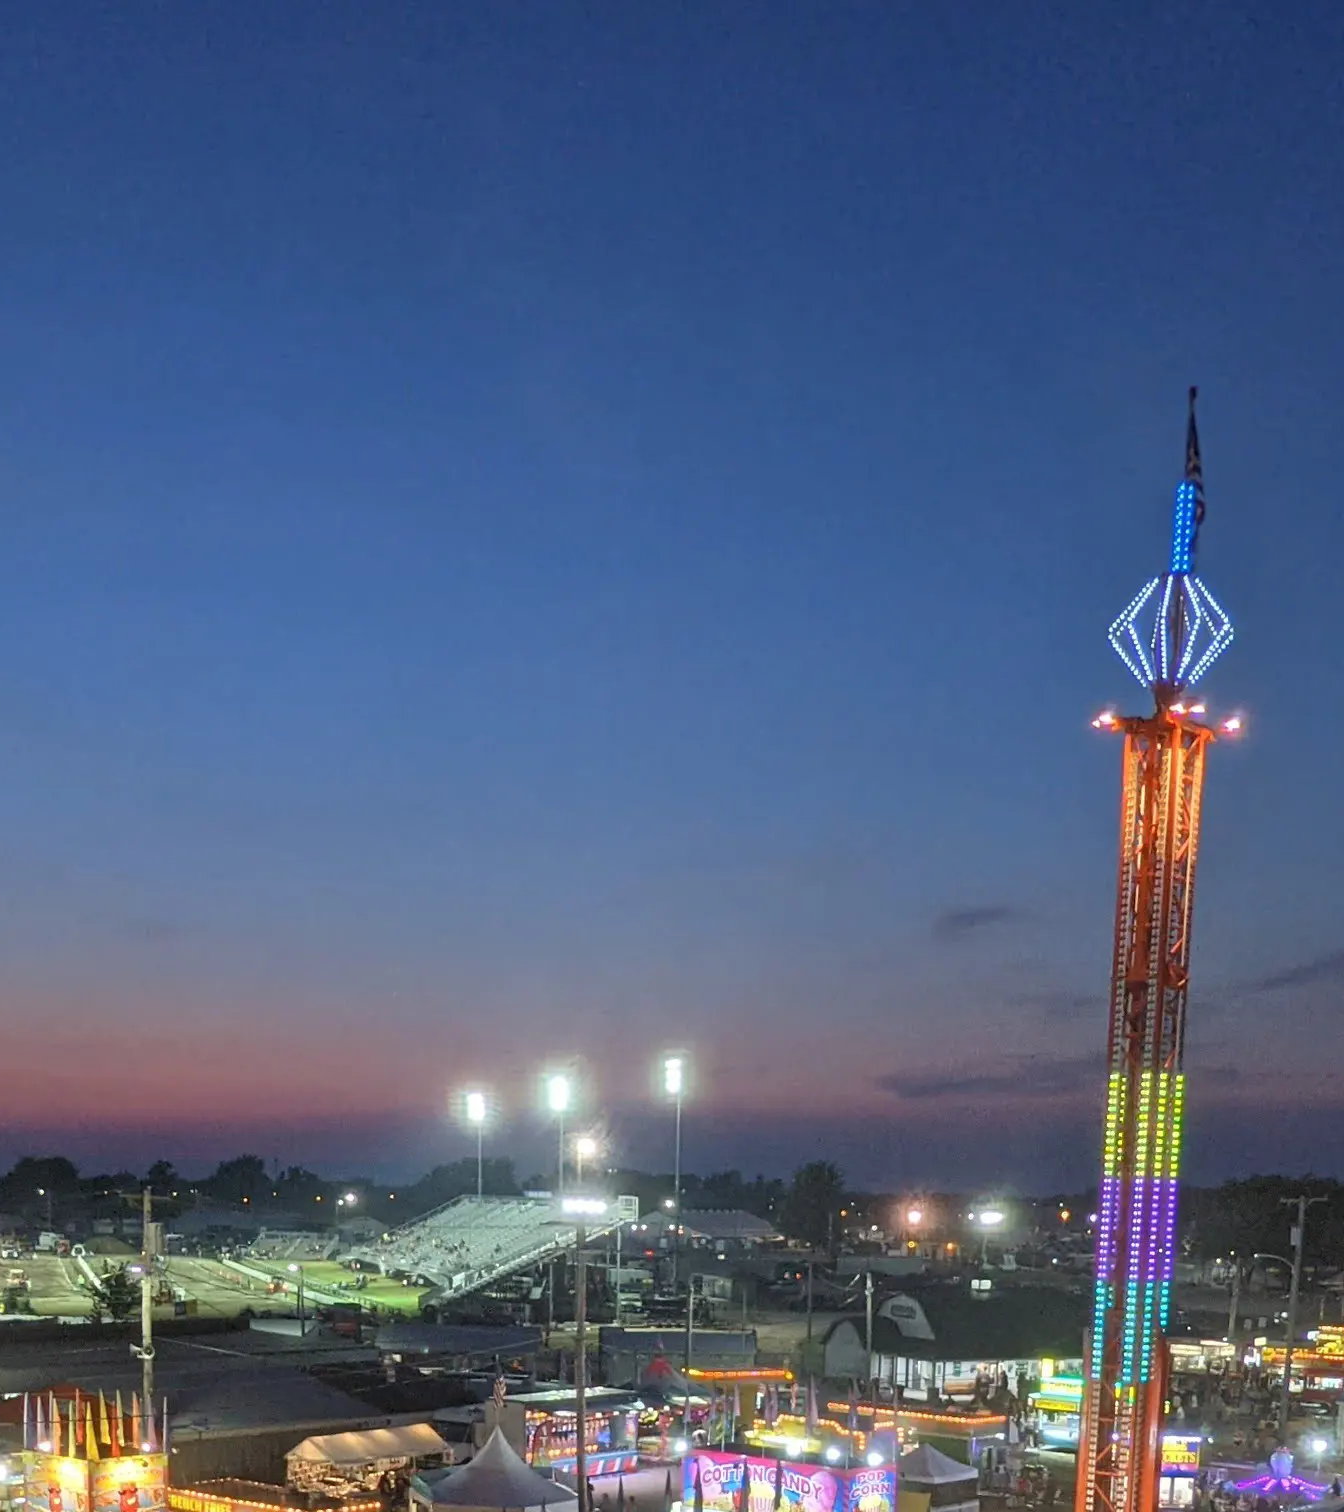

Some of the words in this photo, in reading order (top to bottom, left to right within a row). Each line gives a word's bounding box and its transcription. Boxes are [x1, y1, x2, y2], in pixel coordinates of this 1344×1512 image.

[767, 1467, 824, 1500] CANDY
[857, 1470, 886, 1485] POP
[850, 1480, 892, 1500] CORN
